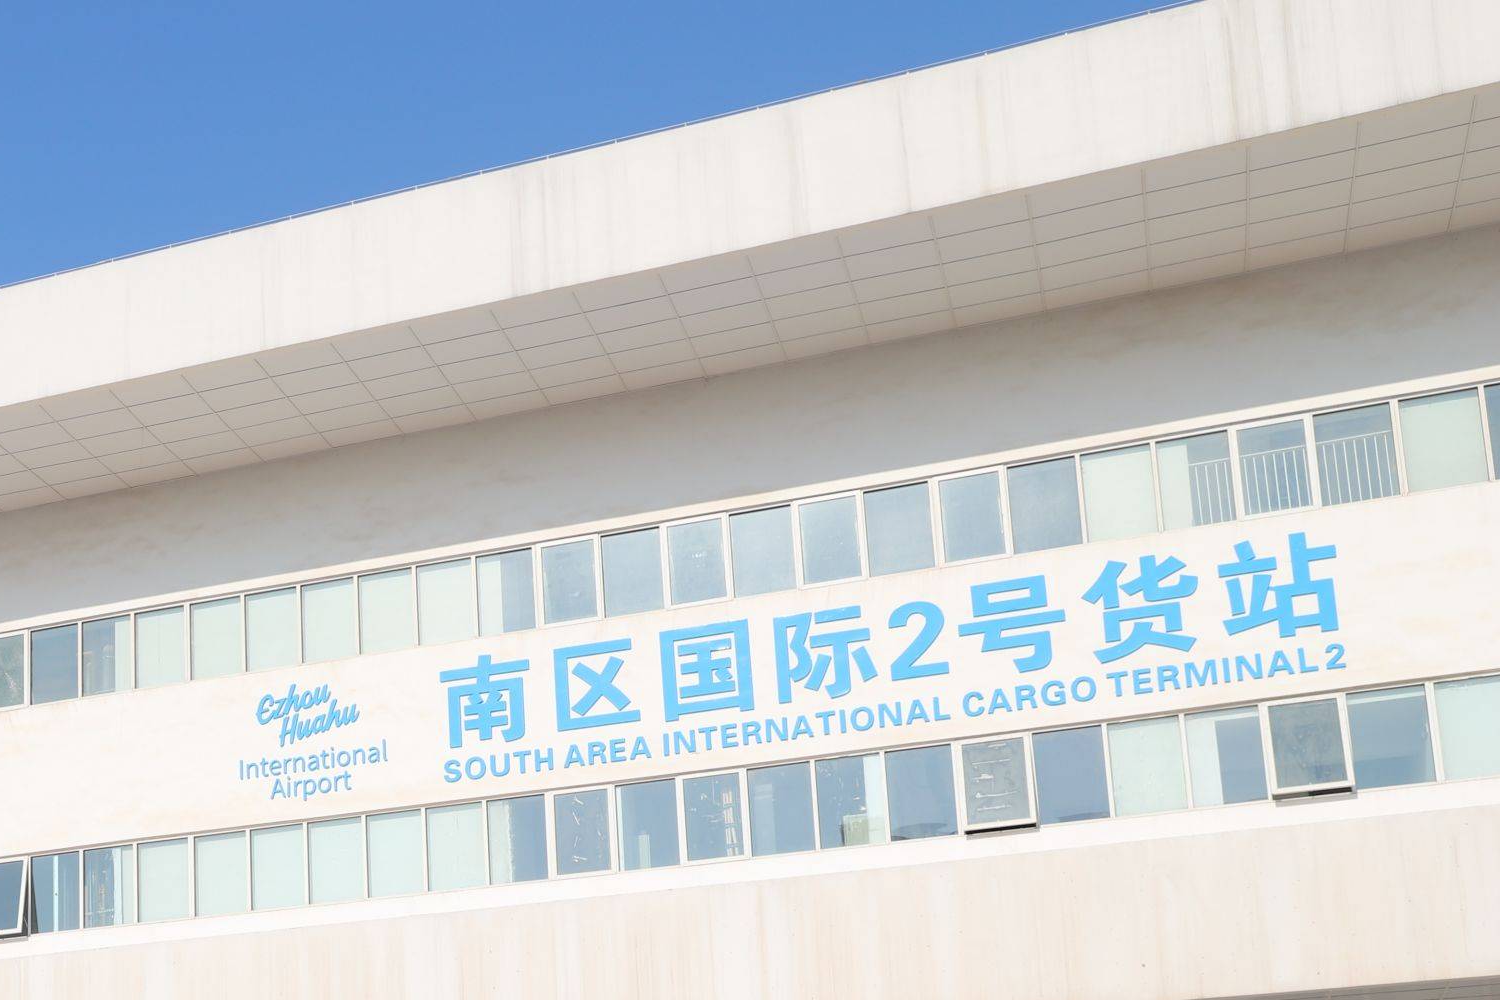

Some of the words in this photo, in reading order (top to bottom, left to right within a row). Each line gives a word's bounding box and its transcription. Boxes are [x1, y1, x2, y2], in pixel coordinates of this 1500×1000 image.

[439, 532, 1339, 749] 南区国际2号货站
[256, 682, 331, 725] Ezhou
[279, 697, 360, 748] Huahu
[444, 748, 554, 783] SOUTH
[565, 736, 652, 768] AREA
[662, 697, 950, 757] INTERNATIONAL
[962, 676, 1098, 718] CARGO
[239, 740, 388, 780] International
[270, 771, 352, 801] Airport
